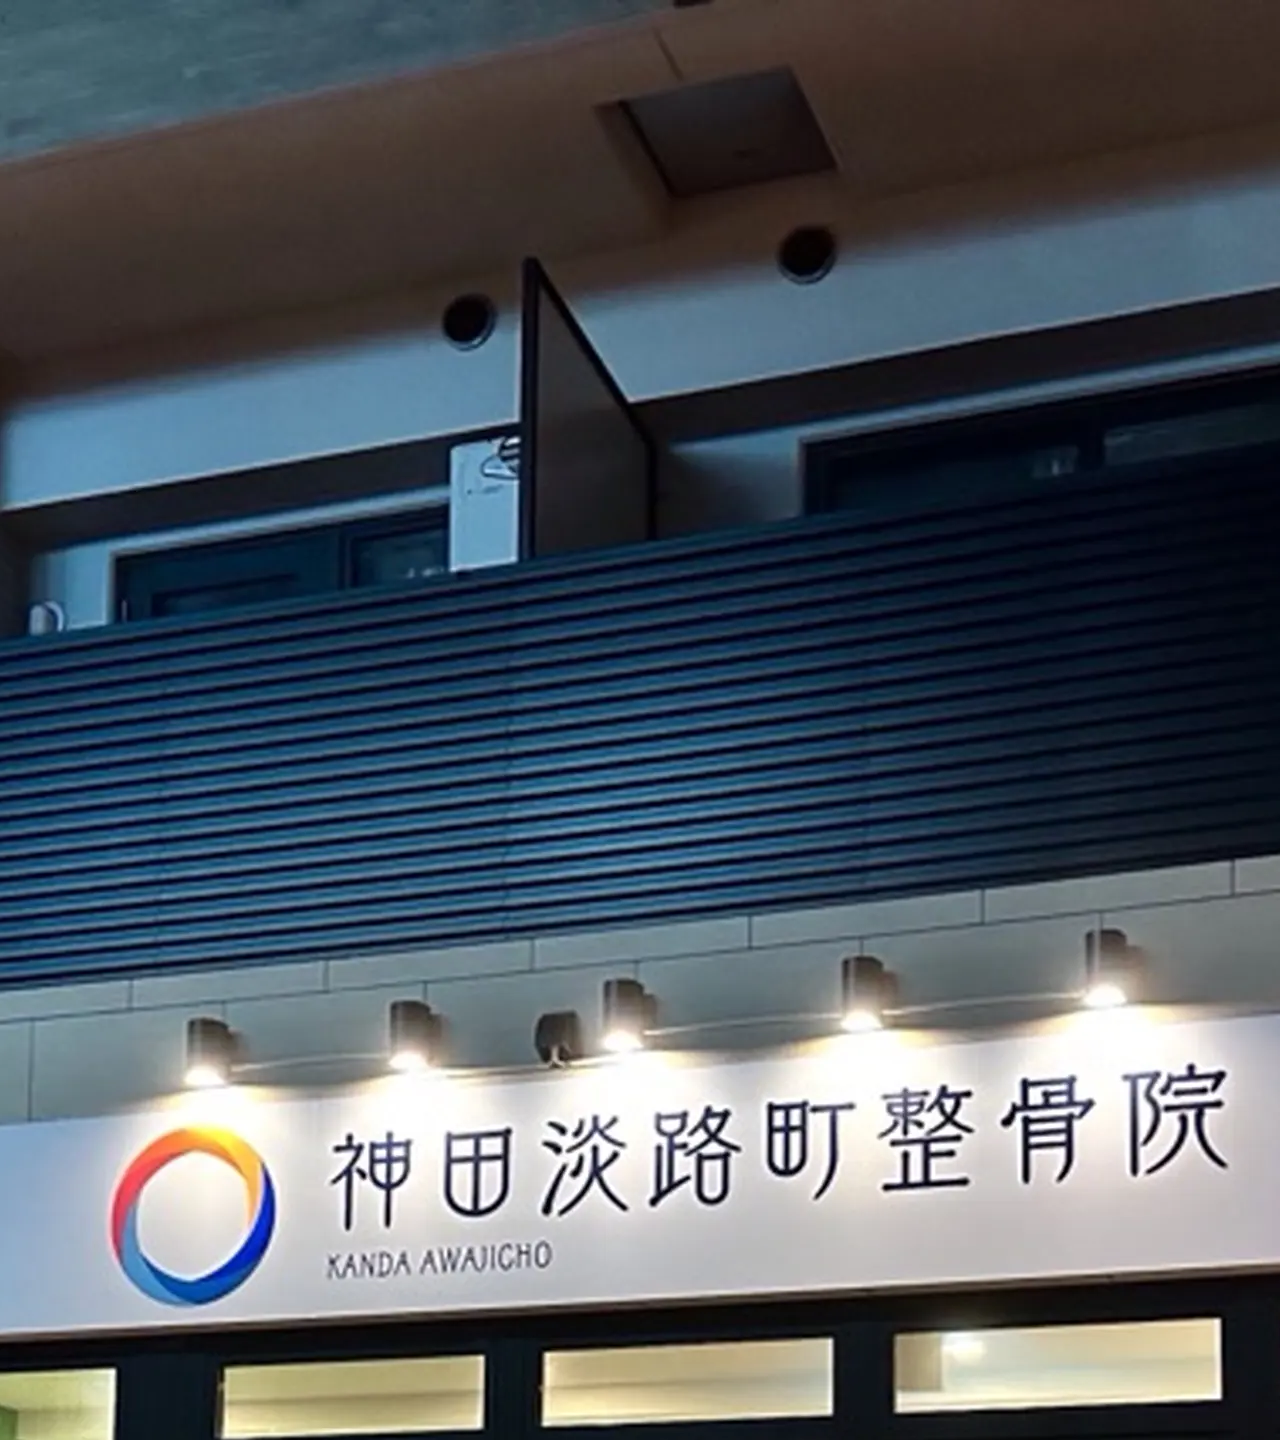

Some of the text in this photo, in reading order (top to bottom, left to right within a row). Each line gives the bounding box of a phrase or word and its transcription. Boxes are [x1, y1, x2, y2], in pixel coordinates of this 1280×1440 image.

[329, 1063, 1228, 1231] 神田淡路町整骨院
[326, 1240, 553, 1280] KANDA AWAJICHO
